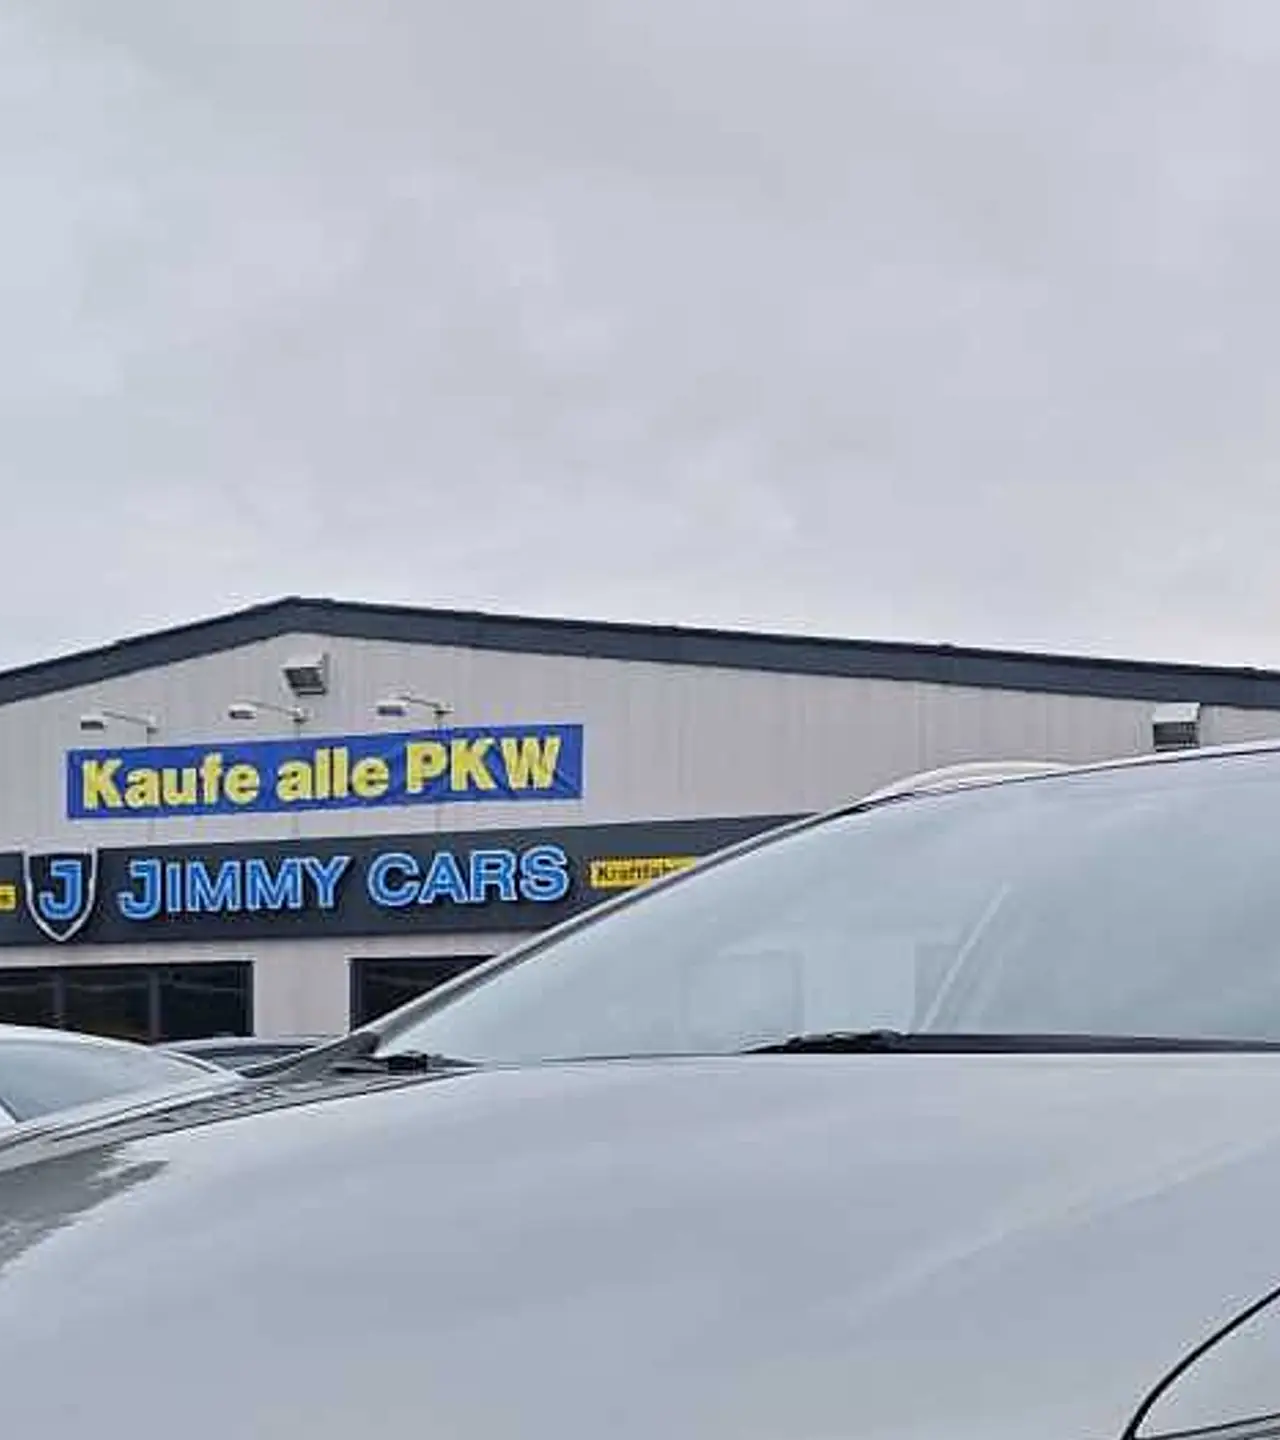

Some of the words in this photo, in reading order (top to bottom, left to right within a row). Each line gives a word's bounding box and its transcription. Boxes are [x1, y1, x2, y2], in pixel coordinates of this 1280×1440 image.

[81, 752, 260, 809] Kaufe
[275, 746, 390, 801] alle
[405, 735, 561, 795] PKW
[38, 858, 83, 921] J
[119, 855, 352, 919] JIMMY
[367, 845, 569, 907] CARS
